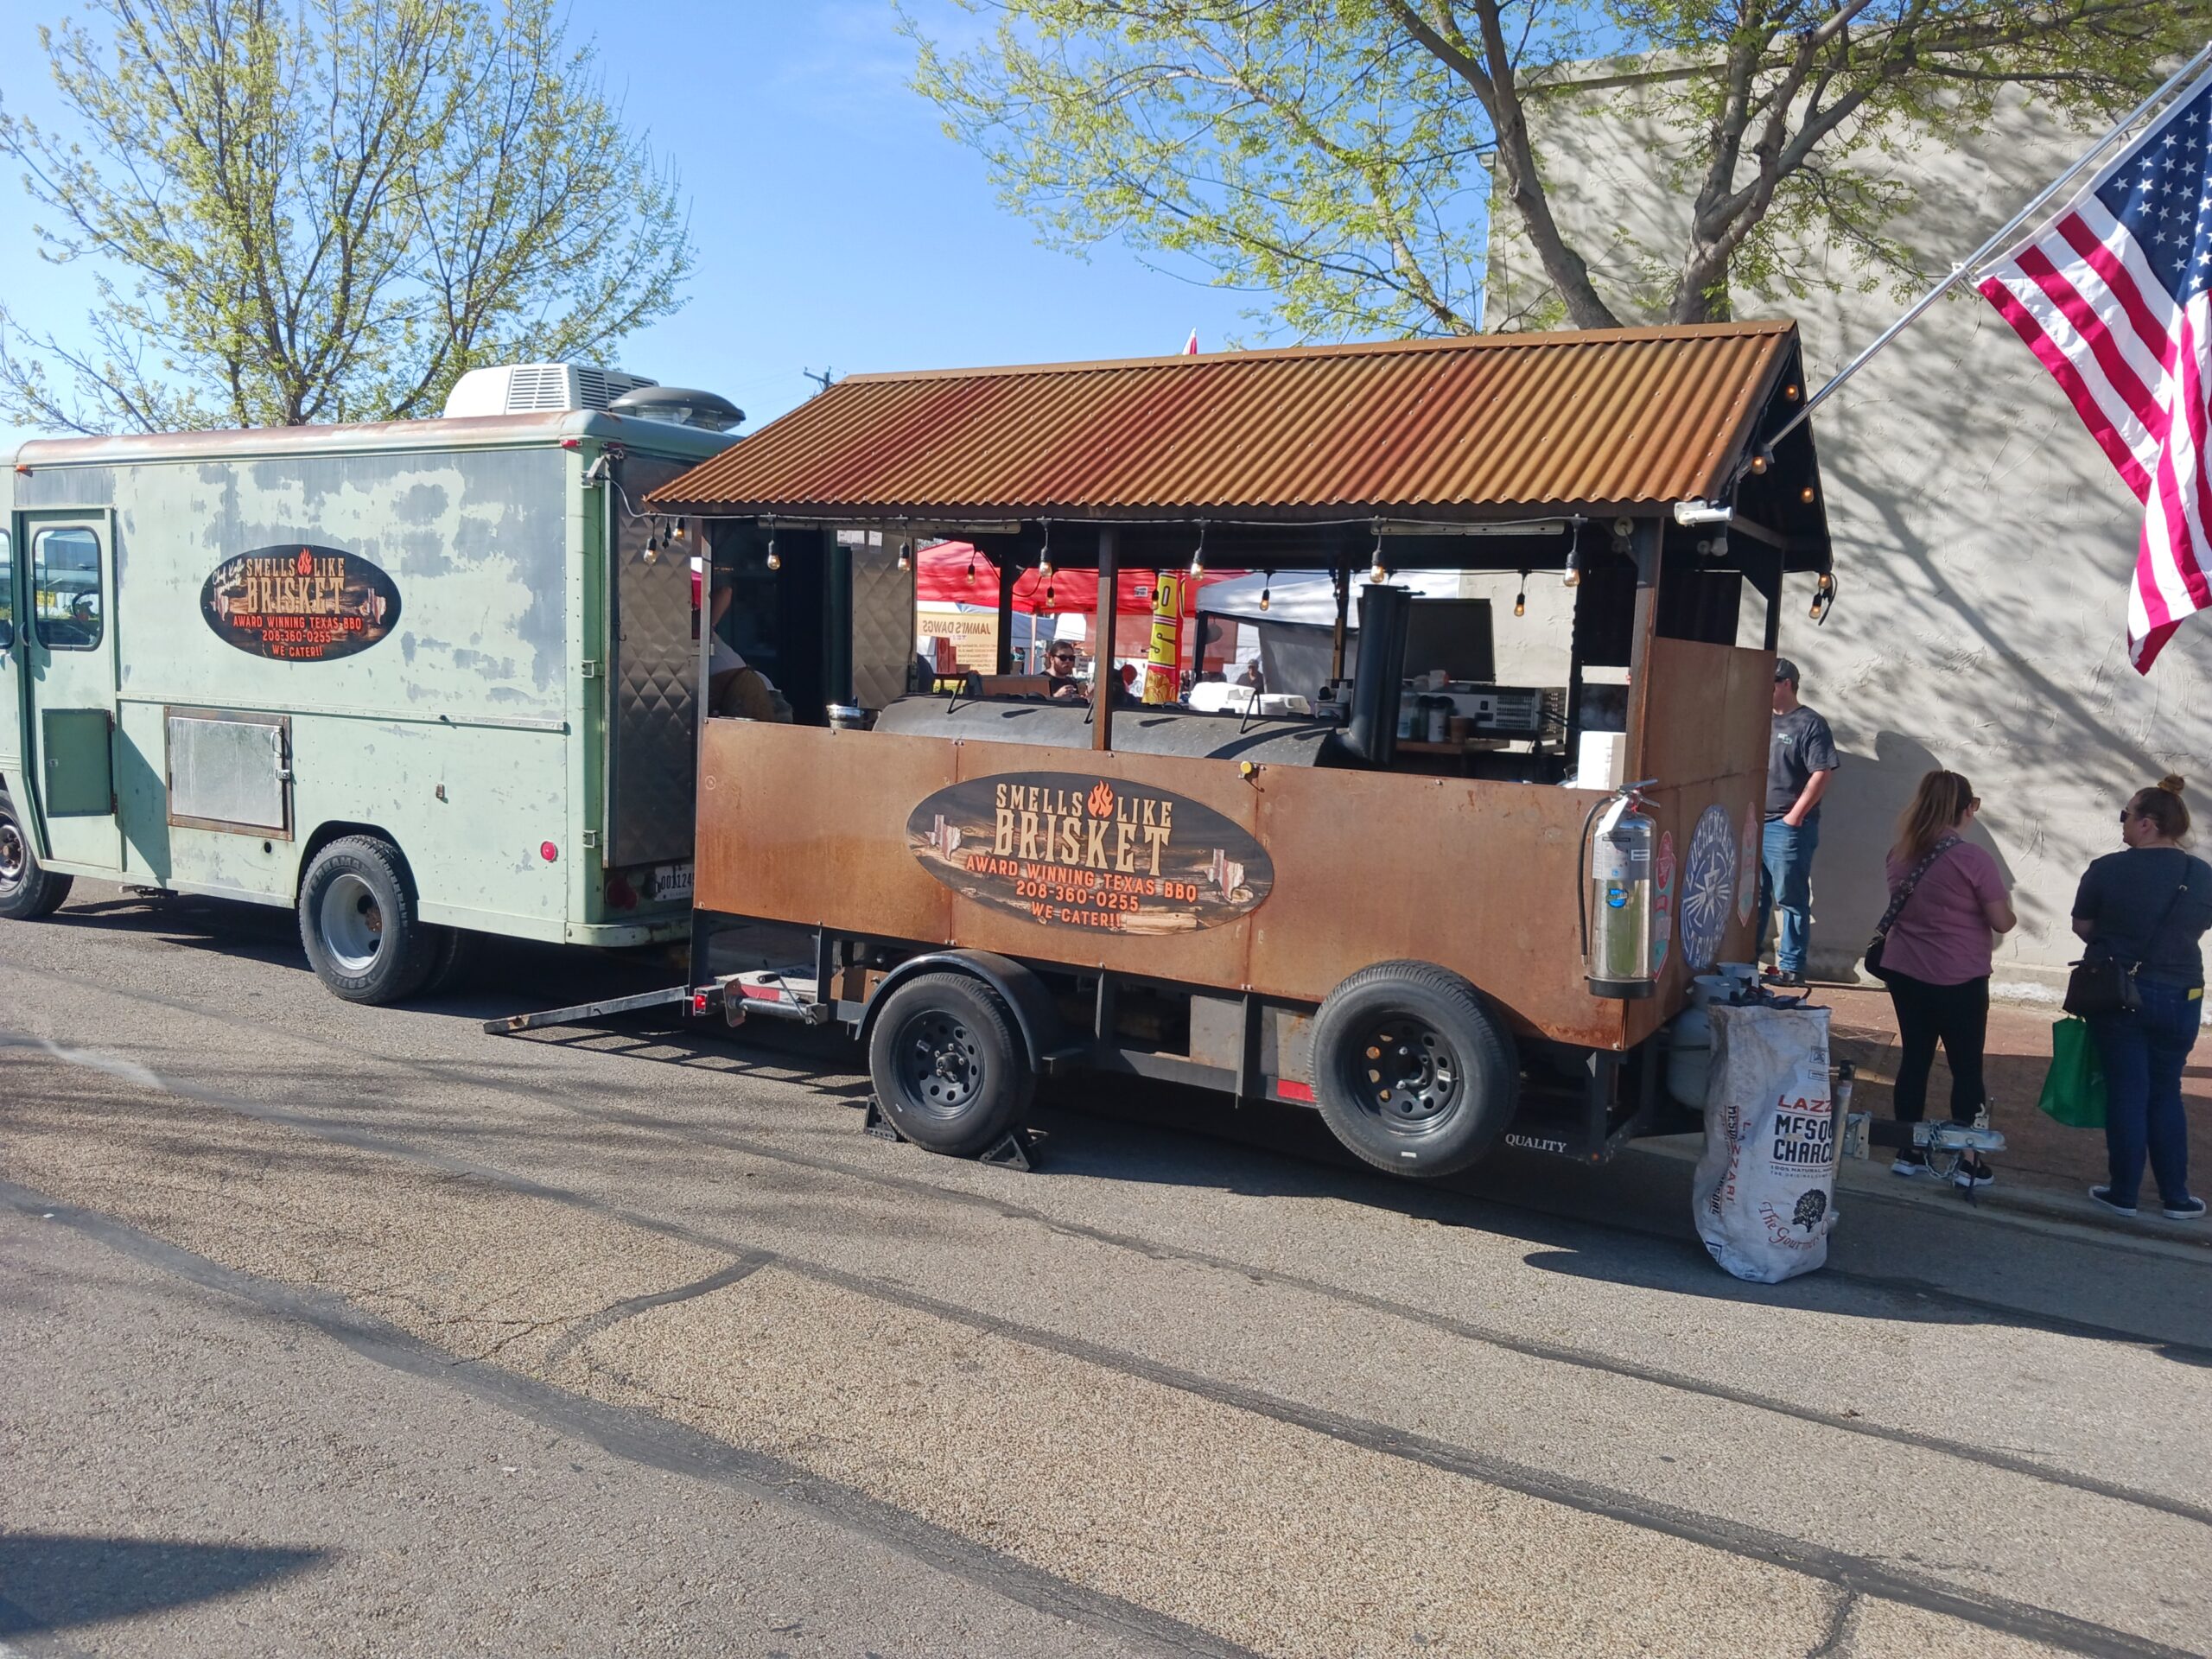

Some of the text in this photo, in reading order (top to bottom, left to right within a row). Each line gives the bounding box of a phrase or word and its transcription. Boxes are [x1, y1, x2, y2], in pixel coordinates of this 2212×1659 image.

[246, 558, 344, 576] SMELLS LIKE
[247, 577, 344, 613] BRISKET
[232, 615, 263, 628] AWARD
[267, 616, 305, 629] WINNING
[309, 617, 339, 629] TEXAS
[262, 629, 331, 643] 208-360-0255
[272, 645, 322, 658] WE CATER!!
[996, 783, 1173, 828] SMELLS LIKE
[994, 808, 1172, 877] BRISKET
[965, 855, 1198, 903] AWARD WINNING TEXAS BBQ
[1016, 880, 1140, 912] 208-360-0255
[1032, 901, 1122, 928] WE CATER!!
[1775, 1114, 1832, 1142] MESQ
[1504, 1133, 1567, 1154] QUALITY
[1773, 1139, 1833, 1164] CHARC
[1758, 1201, 1779, 1230] The
